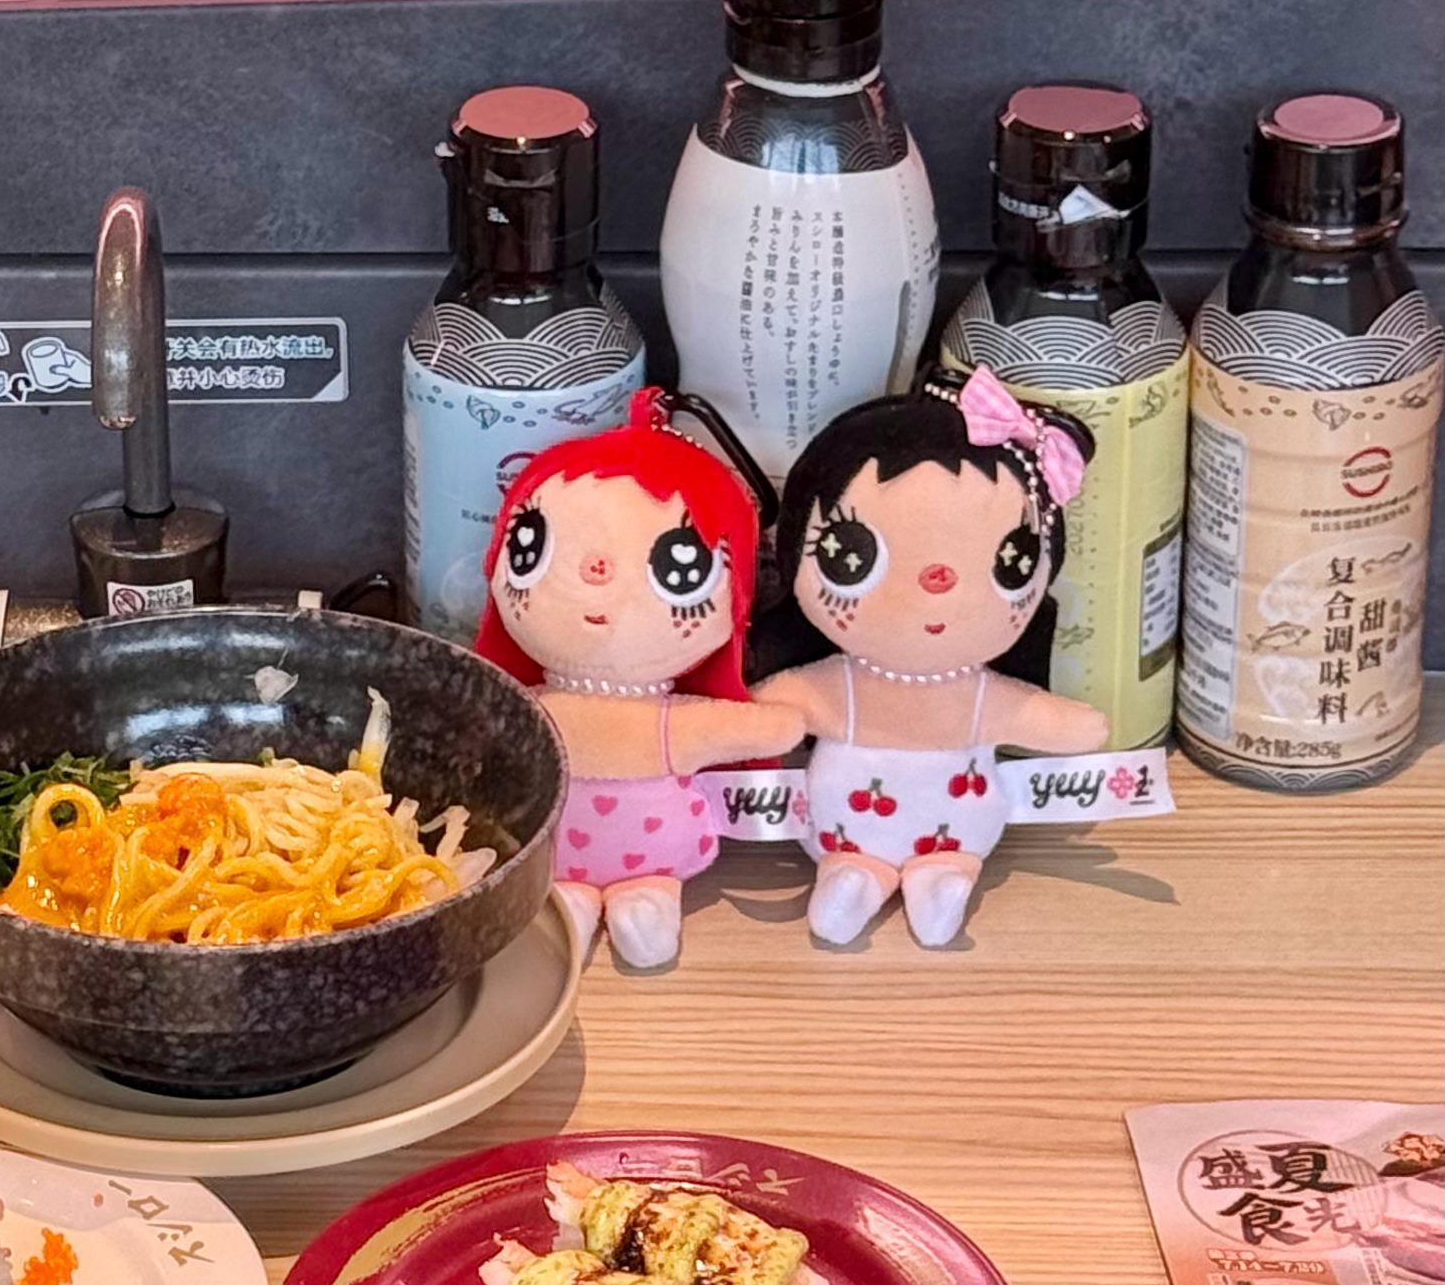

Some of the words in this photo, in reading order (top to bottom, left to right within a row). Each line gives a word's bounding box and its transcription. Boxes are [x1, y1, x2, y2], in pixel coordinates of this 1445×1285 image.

[1316, 556, 1357, 726] 复合调味料
[1355, 597, 1388, 672] 甜酱
